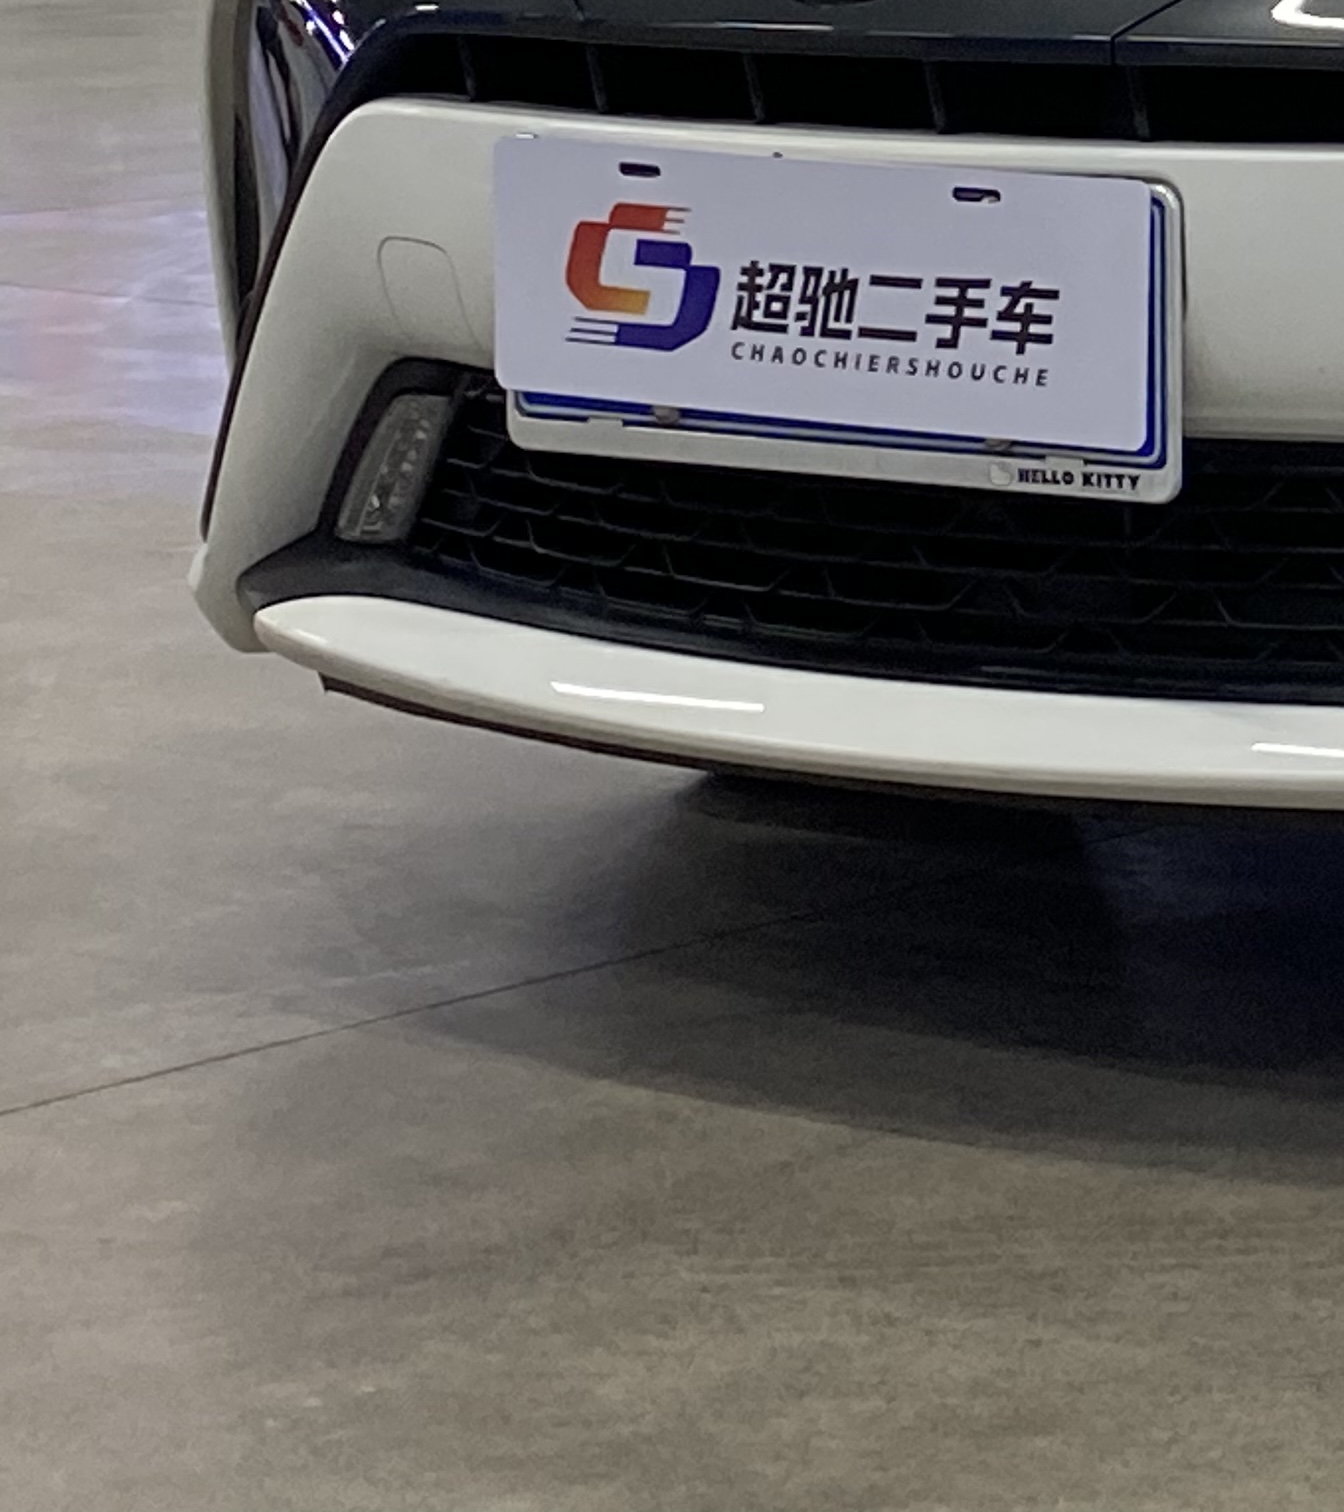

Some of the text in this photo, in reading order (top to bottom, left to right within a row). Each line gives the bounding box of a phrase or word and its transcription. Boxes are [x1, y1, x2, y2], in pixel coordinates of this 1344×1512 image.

[730, 260, 1060, 356] 超驰二手车
[730, 341, 1050, 387] CHAOCHIERSHOUCHE
[1018, 468, 1141, 491] HELLO KITTY
